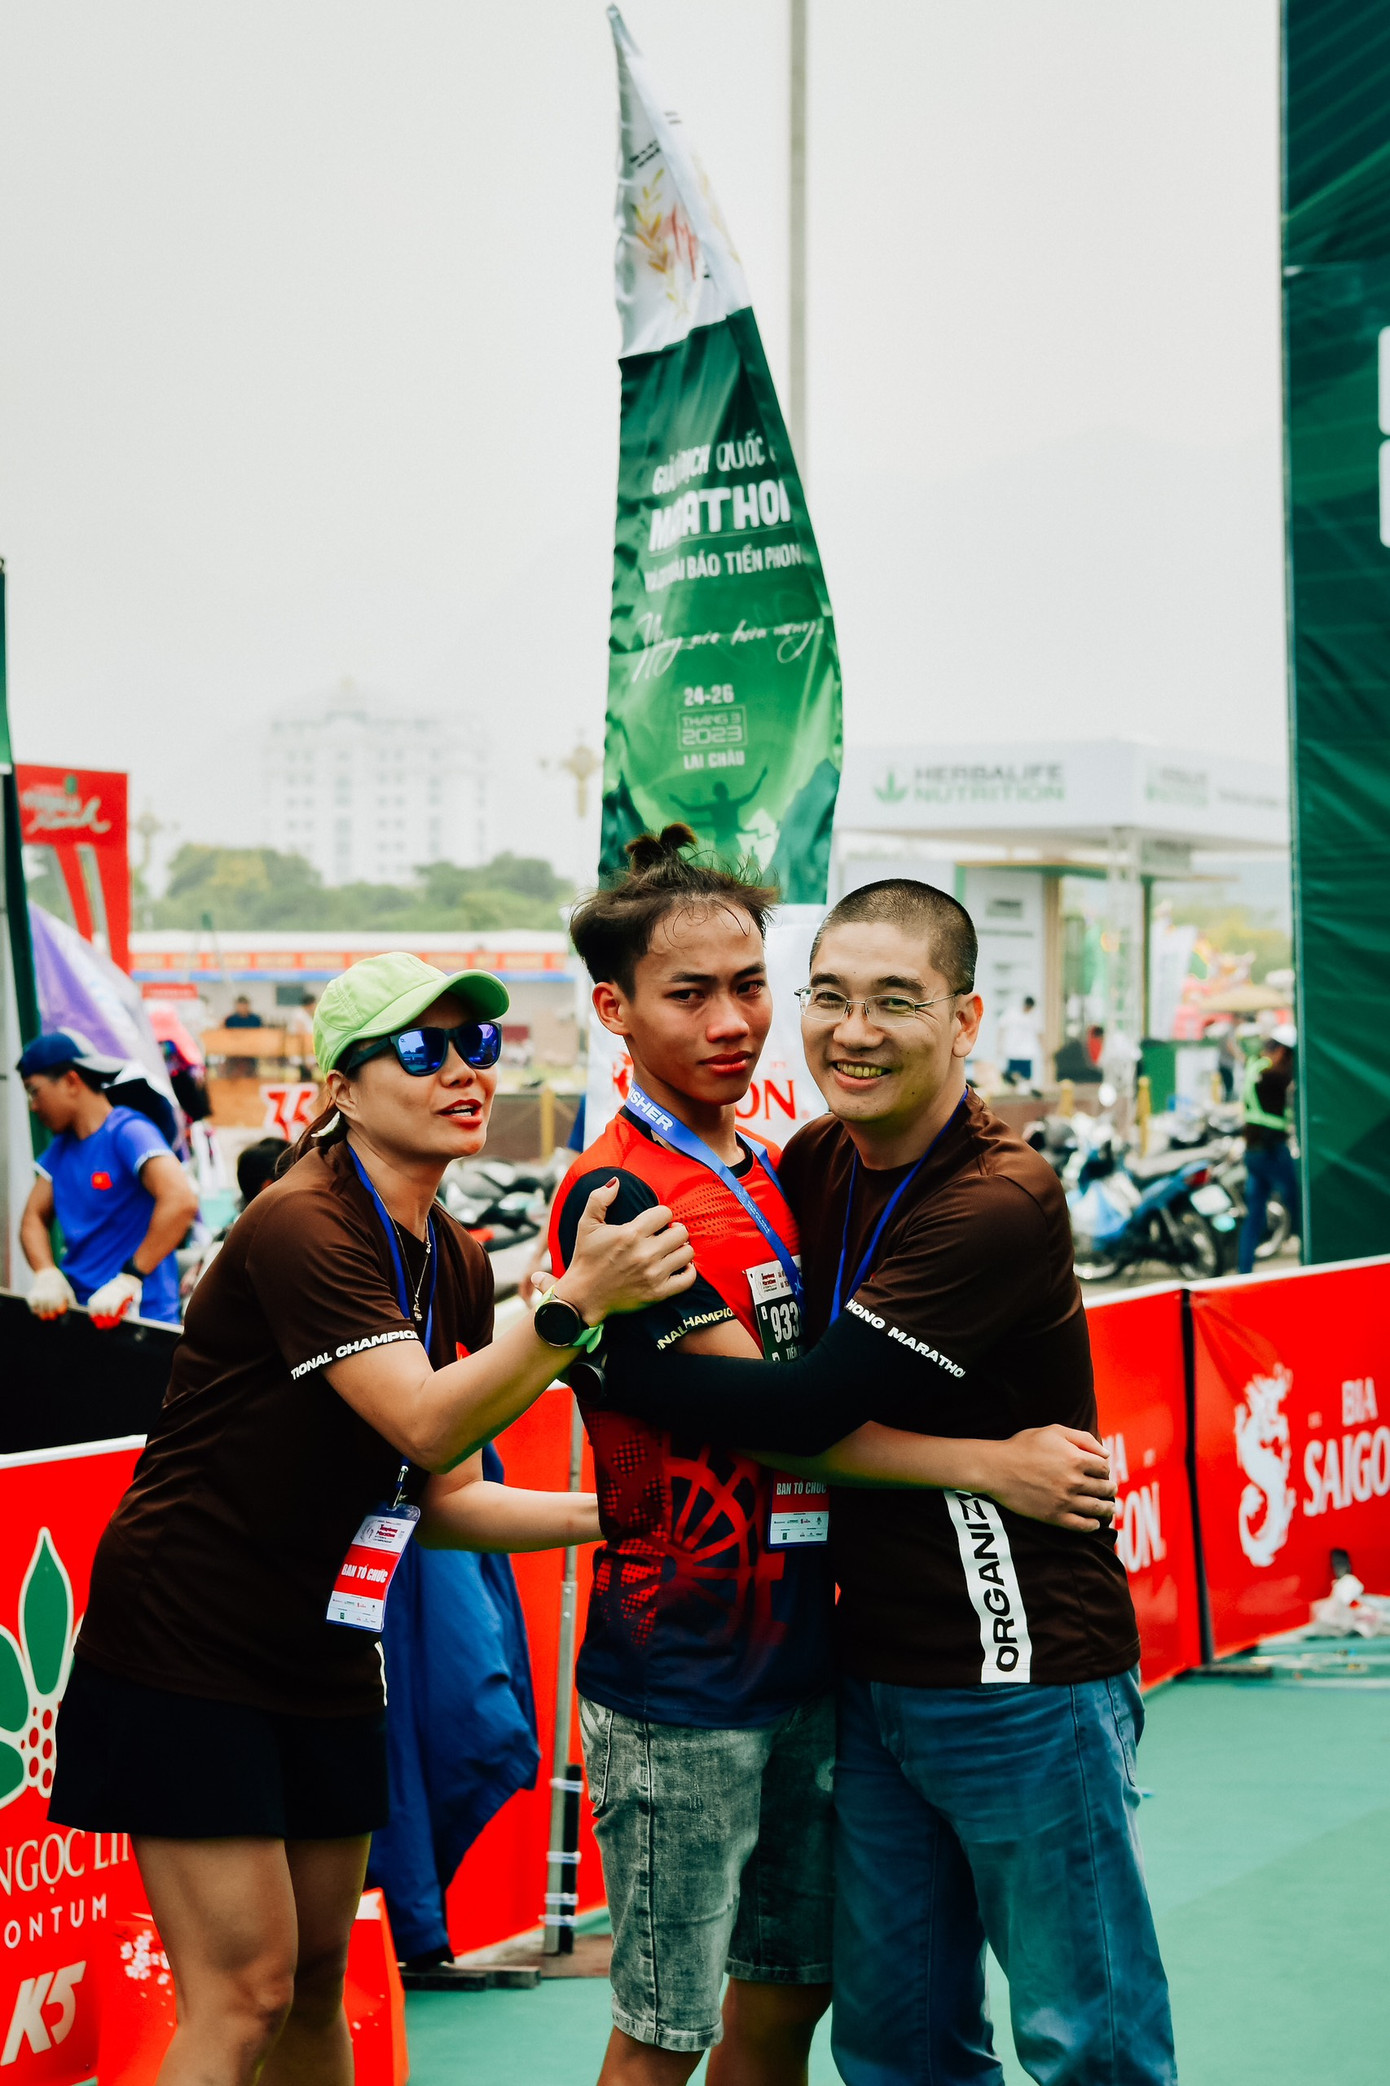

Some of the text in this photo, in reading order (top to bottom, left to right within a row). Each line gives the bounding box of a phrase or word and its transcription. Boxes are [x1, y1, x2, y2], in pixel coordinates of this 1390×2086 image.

[687, 549, 721, 579] BÁO
[765, 542, 806, 571] PHON
[684, 683, 735, 706] 24-26
[682, 725, 743, 746] 2023
[684, 749, 746, 770] LAI CHÂU
[656, 1326, 687, 1350] NAL
[888, 1326, 966, 1378] MARATHO
[290, 1352, 333, 1380] TIONAL
[1342, 1376, 1379, 1428] BIA
[1303, 1425, 1390, 1518] SAIGO
[777, 1482, 792, 1495] BAN
[341, 1564, 358, 1578] BAN
[4, 1893, 107, 1949] ONTUM
[0, 1960, 87, 2066] K5
